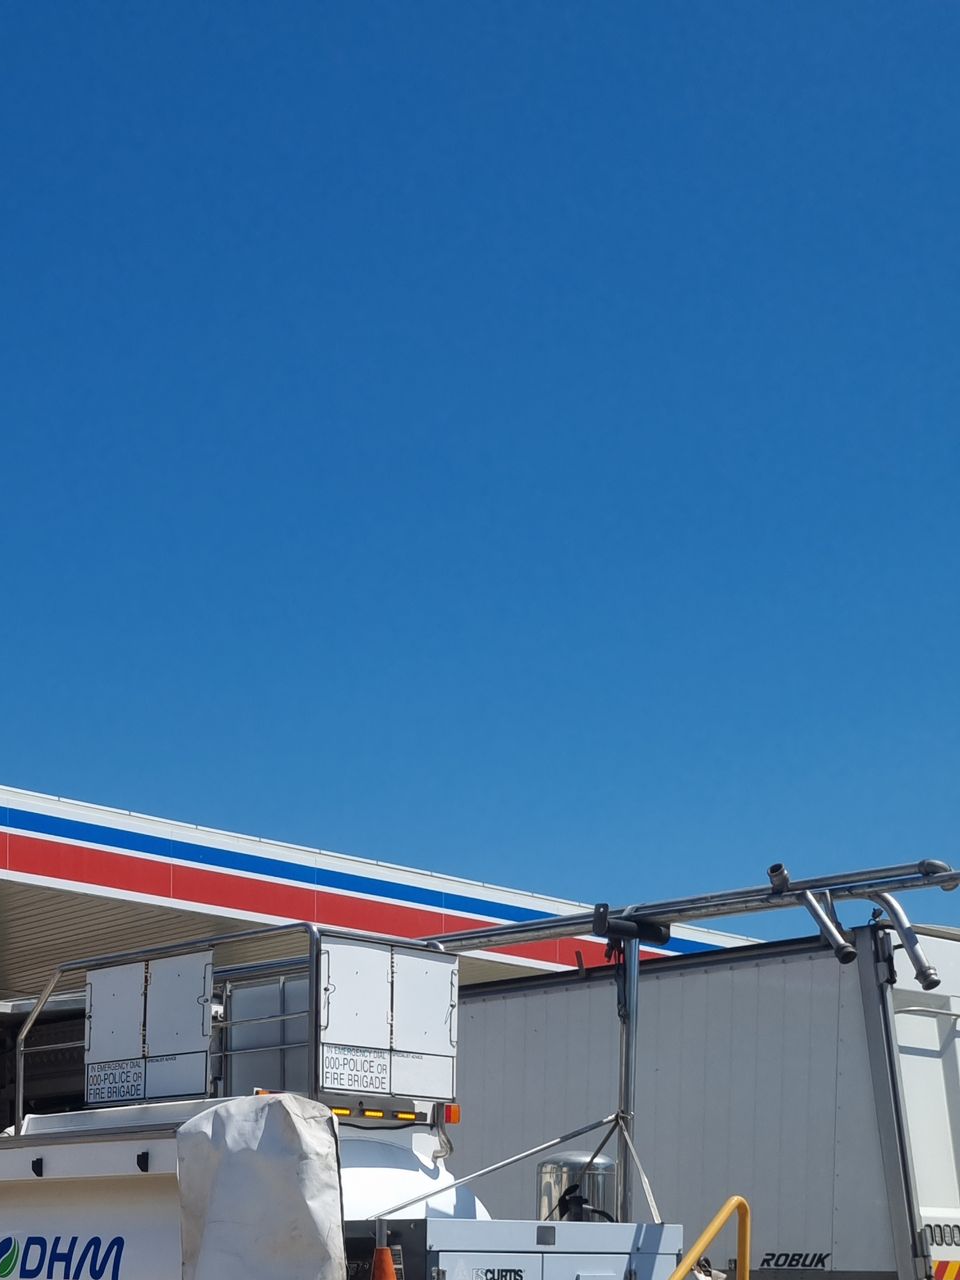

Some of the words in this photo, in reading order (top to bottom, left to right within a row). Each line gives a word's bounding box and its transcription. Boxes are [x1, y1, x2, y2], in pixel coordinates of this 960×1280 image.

[334, 1046, 372, 1059] EMERGENCY
[97, 1062, 129, 1072] EMERGENCY
[130, 1060, 142, 1069] DIAL
[324, 1056, 375, 1074] 000-POLICE
[376, 1063, 388, 1075] OR
[89, 1071, 131, 1087] 000-POLICE
[132, 1071, 143, 1083] OR
[324, 1071, 345, 1086] FIRE
[347, 1073, 387, 1090] BRIGADE
[88, 1087, 105, 1100] FIRE
[107, 1084, 141, 1099] BRIGADE
[760, 1253, 831, 1268] ROBUK
